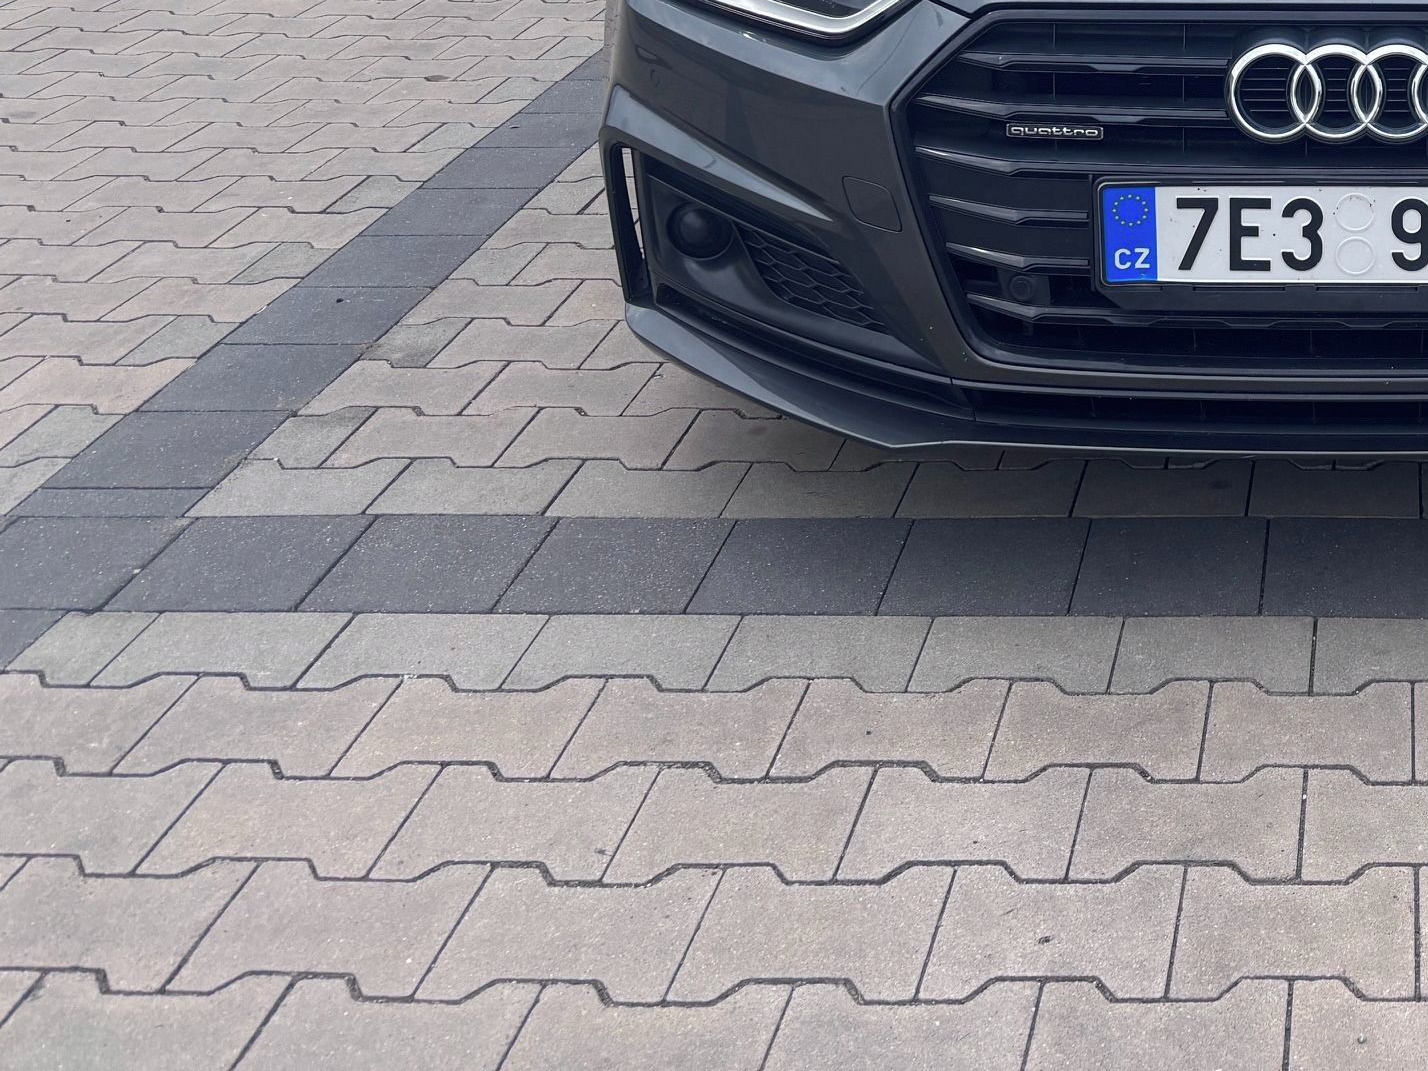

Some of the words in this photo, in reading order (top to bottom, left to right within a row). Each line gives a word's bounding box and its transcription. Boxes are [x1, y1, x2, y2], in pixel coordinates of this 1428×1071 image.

[1011, 126, 1098, 137] quattro
[1176, 196, 1324, 272] 7E3
[1114, 247, 1150, 270] CZ
